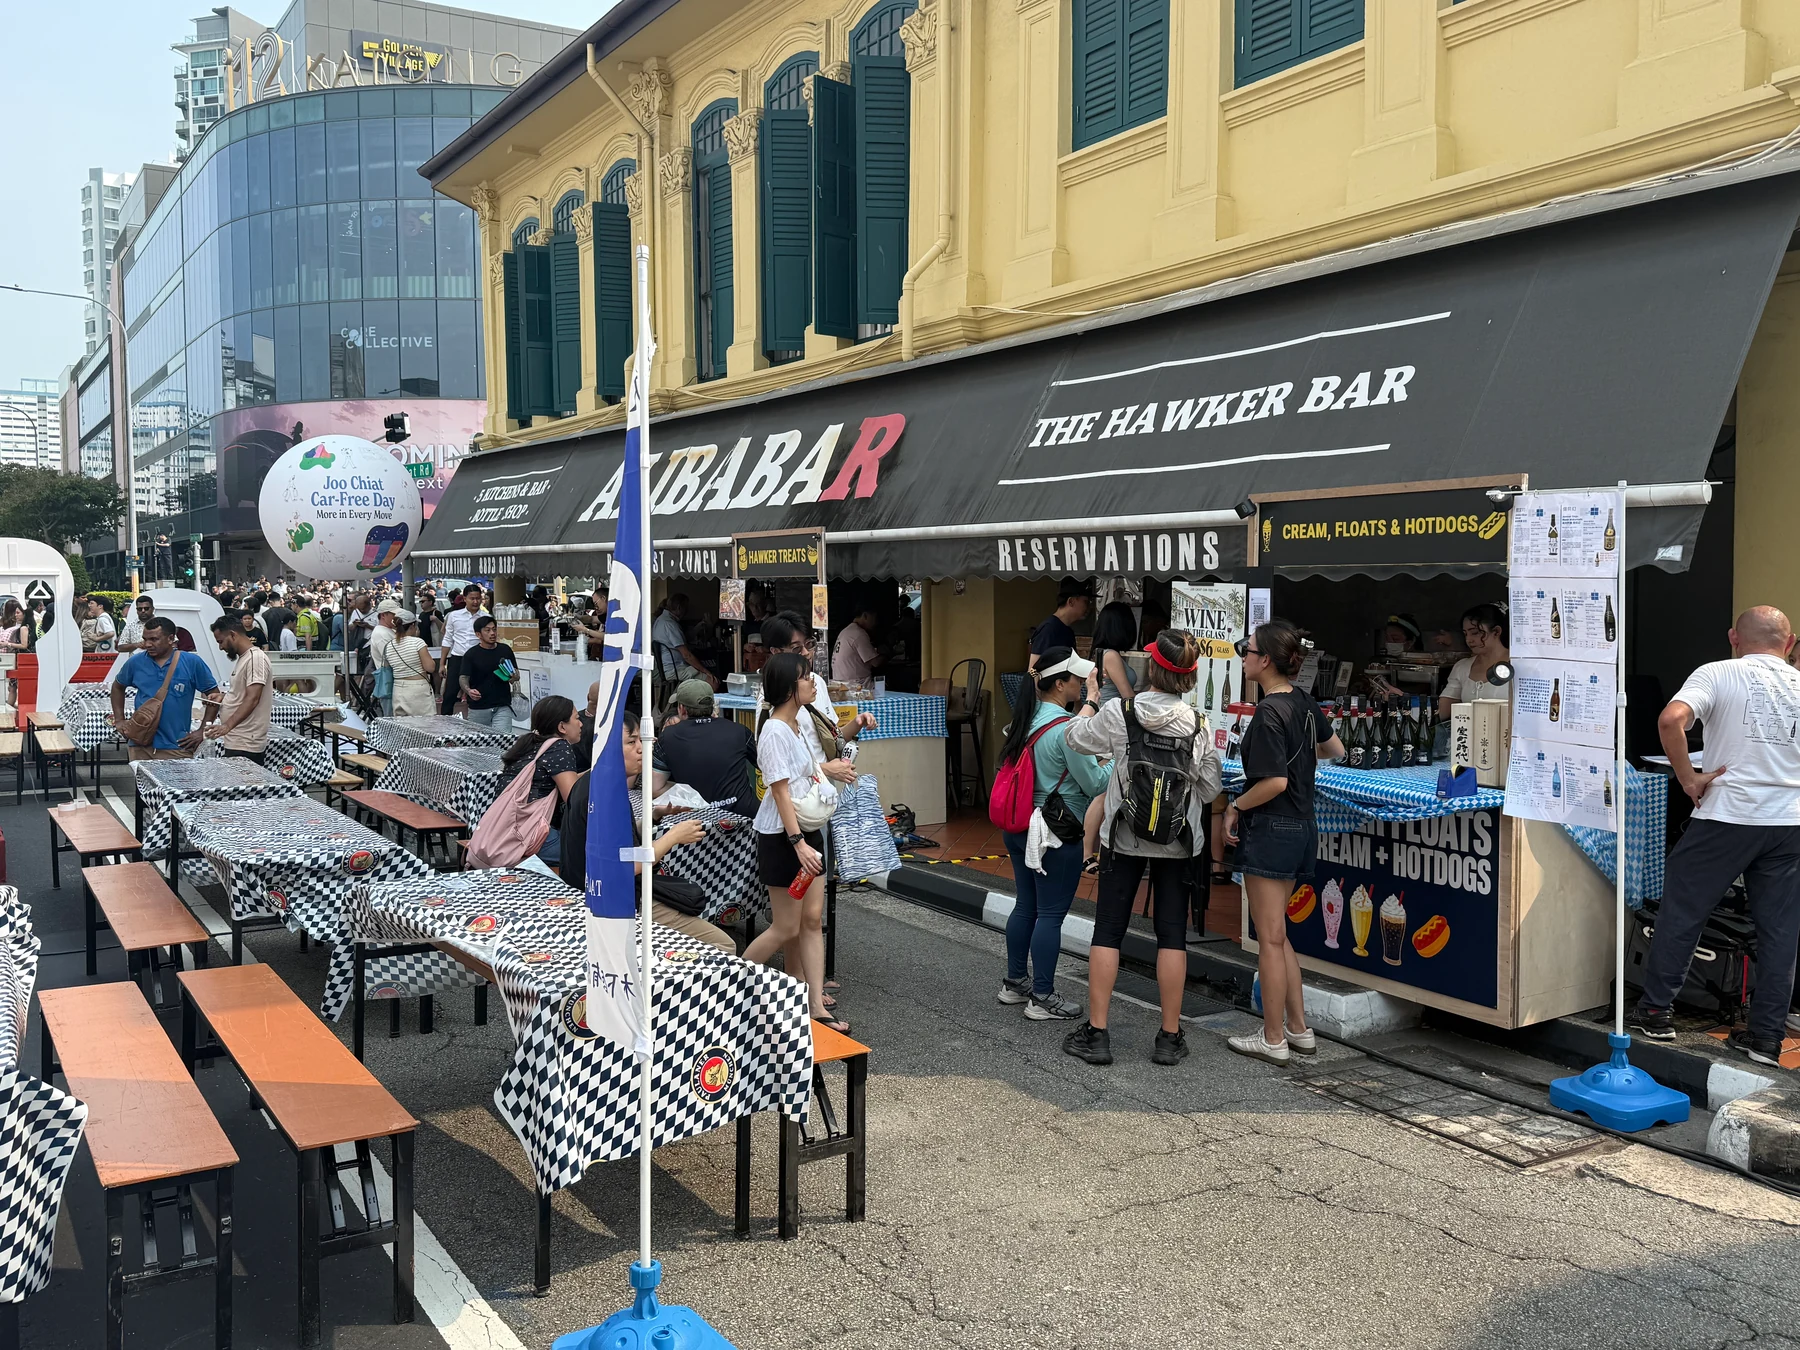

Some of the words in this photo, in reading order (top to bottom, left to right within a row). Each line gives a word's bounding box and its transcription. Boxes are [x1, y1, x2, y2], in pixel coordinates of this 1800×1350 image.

[383, 39, 422, 57] GOLDEN
[305, 48, 522, 90] KATONG
[376, 51, 424, 72] VILLAGE
[1028, 411, 1103, 448] THE
[1098, 381, 1294, 440] HAWKER
[1297, 364, 1416, 414] BAR
[387, 445, 469, 468] OMIN
[419, 464, 430, 476] Rd
[577, 413, 906, 522] AIBABAR
[323, 476, 347, 490] Joo
[350, 476, 385, 491] Chiat
[416, 477, 443, 489] ext
[519, 481, 531, 496] &
[311, 491, 370, 507] Car-Free
[373, 493, 396, 510] Day
[316, 509, 337, 520] More
[339, 509, 347, 519] in
[349, 510, 372, 521] Every
[373, 511, 392, 520] Move
[501, 504, 528, 520] SHOP
[1282, 523, 1331, 541] CREAM,
[1335, 519, 1387, 537] FLOATS
[1390, 518, 1401, 535] &
[1405, 514, 1479, 534] HOTDOGS
[680, 550, 717, 573] LUNCH
[748, 549, 778, 564] HAWKER
[778, 548, 807, 563] TREATS
[998, 531, 1220, 572] RESERVATIONS
[1184, 608, 1227, 630] WINE
[1193, 629, 1205, 638] THE
[1206, 630, 1226, 640] GLASS
[1200, 639, 1213, 657] $6
[1317, 831, 1371, 870] REAM
[1393, 842, 1492, 895] HOTDOGS
[694, 1053, 711, 1101] PAULANER
